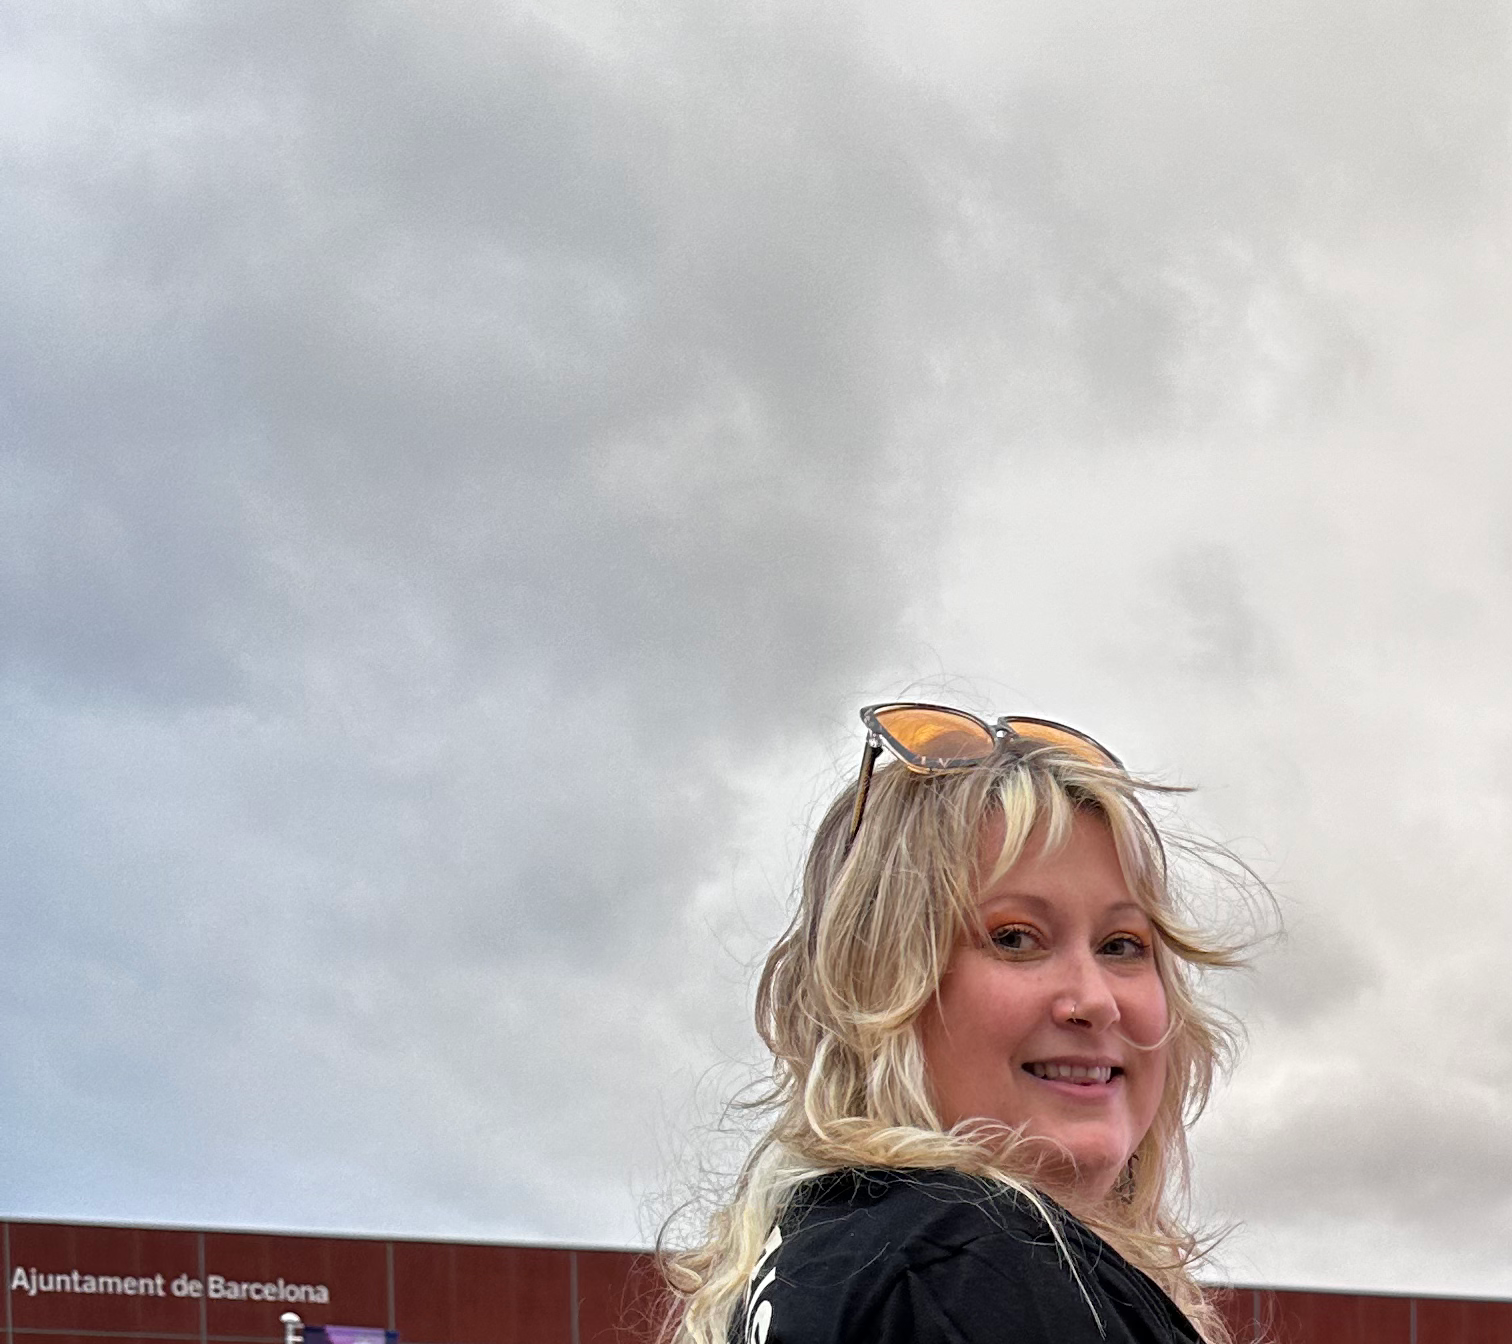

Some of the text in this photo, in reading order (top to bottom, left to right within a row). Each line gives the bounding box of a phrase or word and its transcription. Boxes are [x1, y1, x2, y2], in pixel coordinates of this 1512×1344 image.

[11, 1266, 331, 1305] Ajuntament de Barcelona
